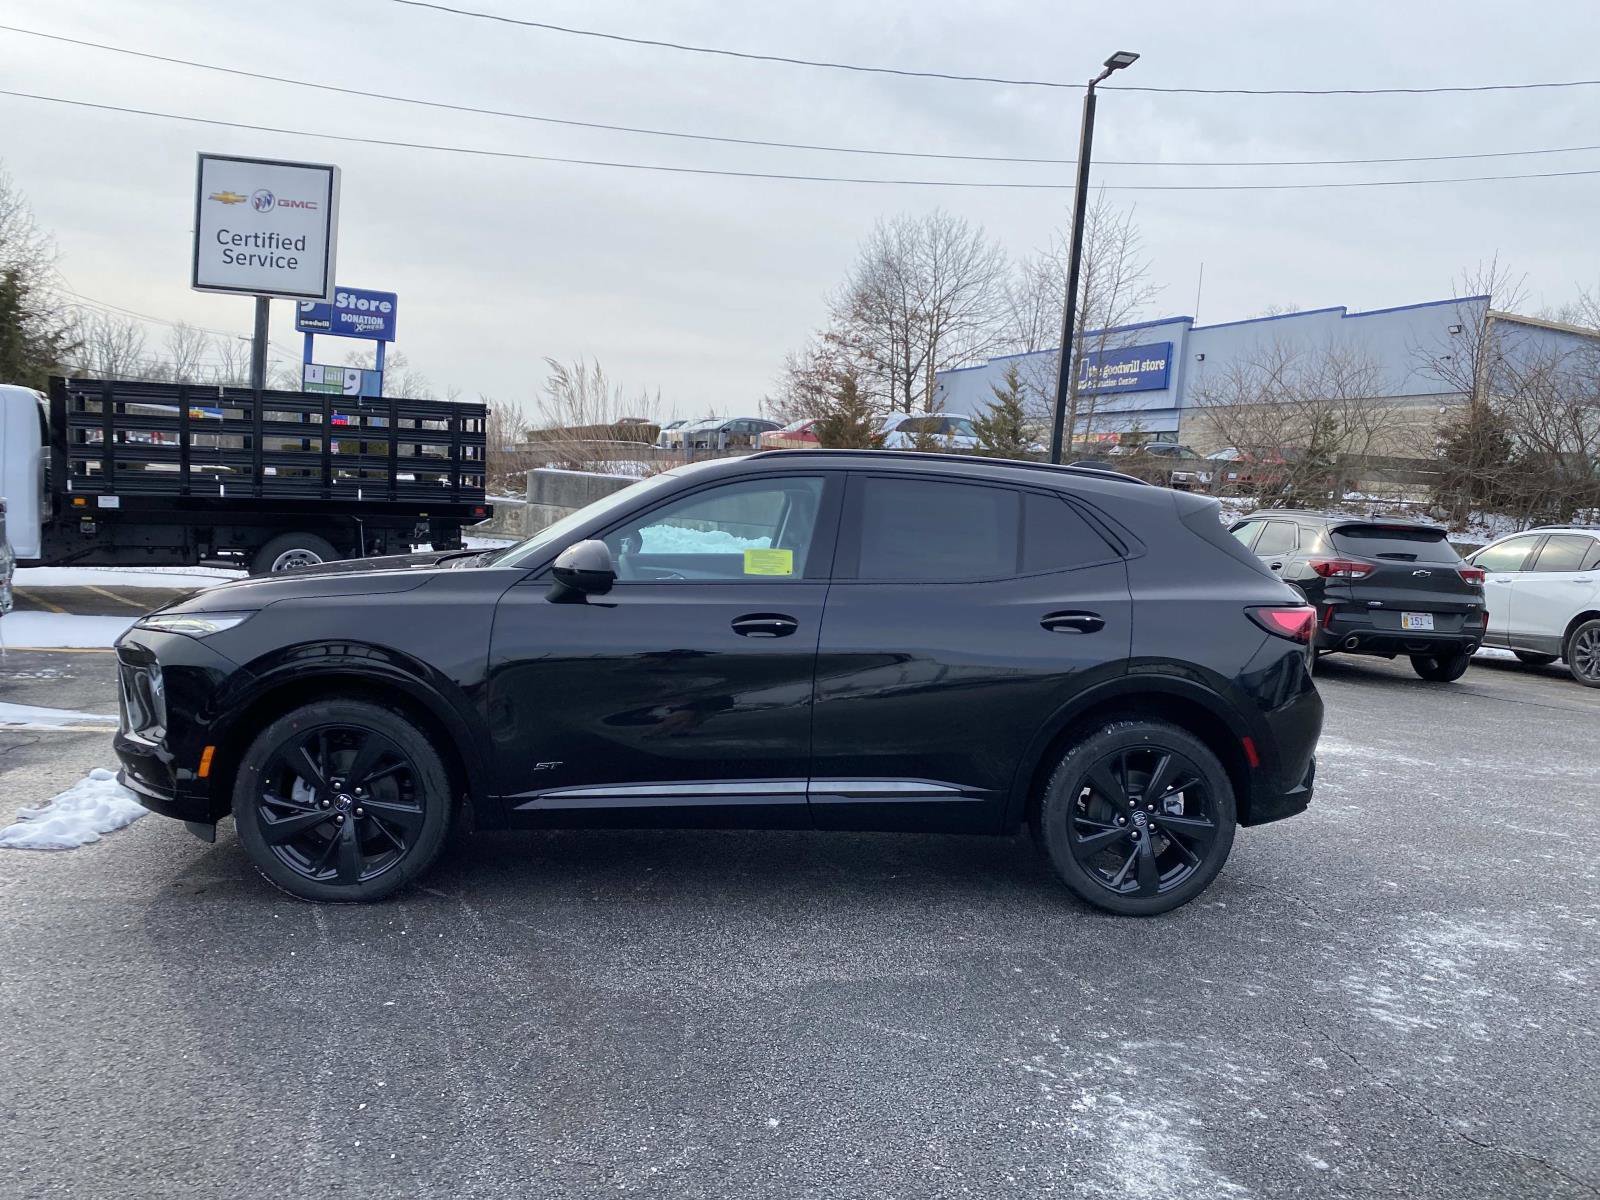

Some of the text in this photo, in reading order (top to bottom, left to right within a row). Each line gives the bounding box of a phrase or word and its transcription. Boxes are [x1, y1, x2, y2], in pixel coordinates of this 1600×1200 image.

[277, 199, 318, 210] GMC
[216, 229, 306, 252] Certified
[222, 248, 298, 270] Service
[336, 292, 392, 313] Store
[341, 313, 384, 325] DONATION
[1103, 360, 1140, 378] goodwill
[1142, 359, 1165, 371] store
